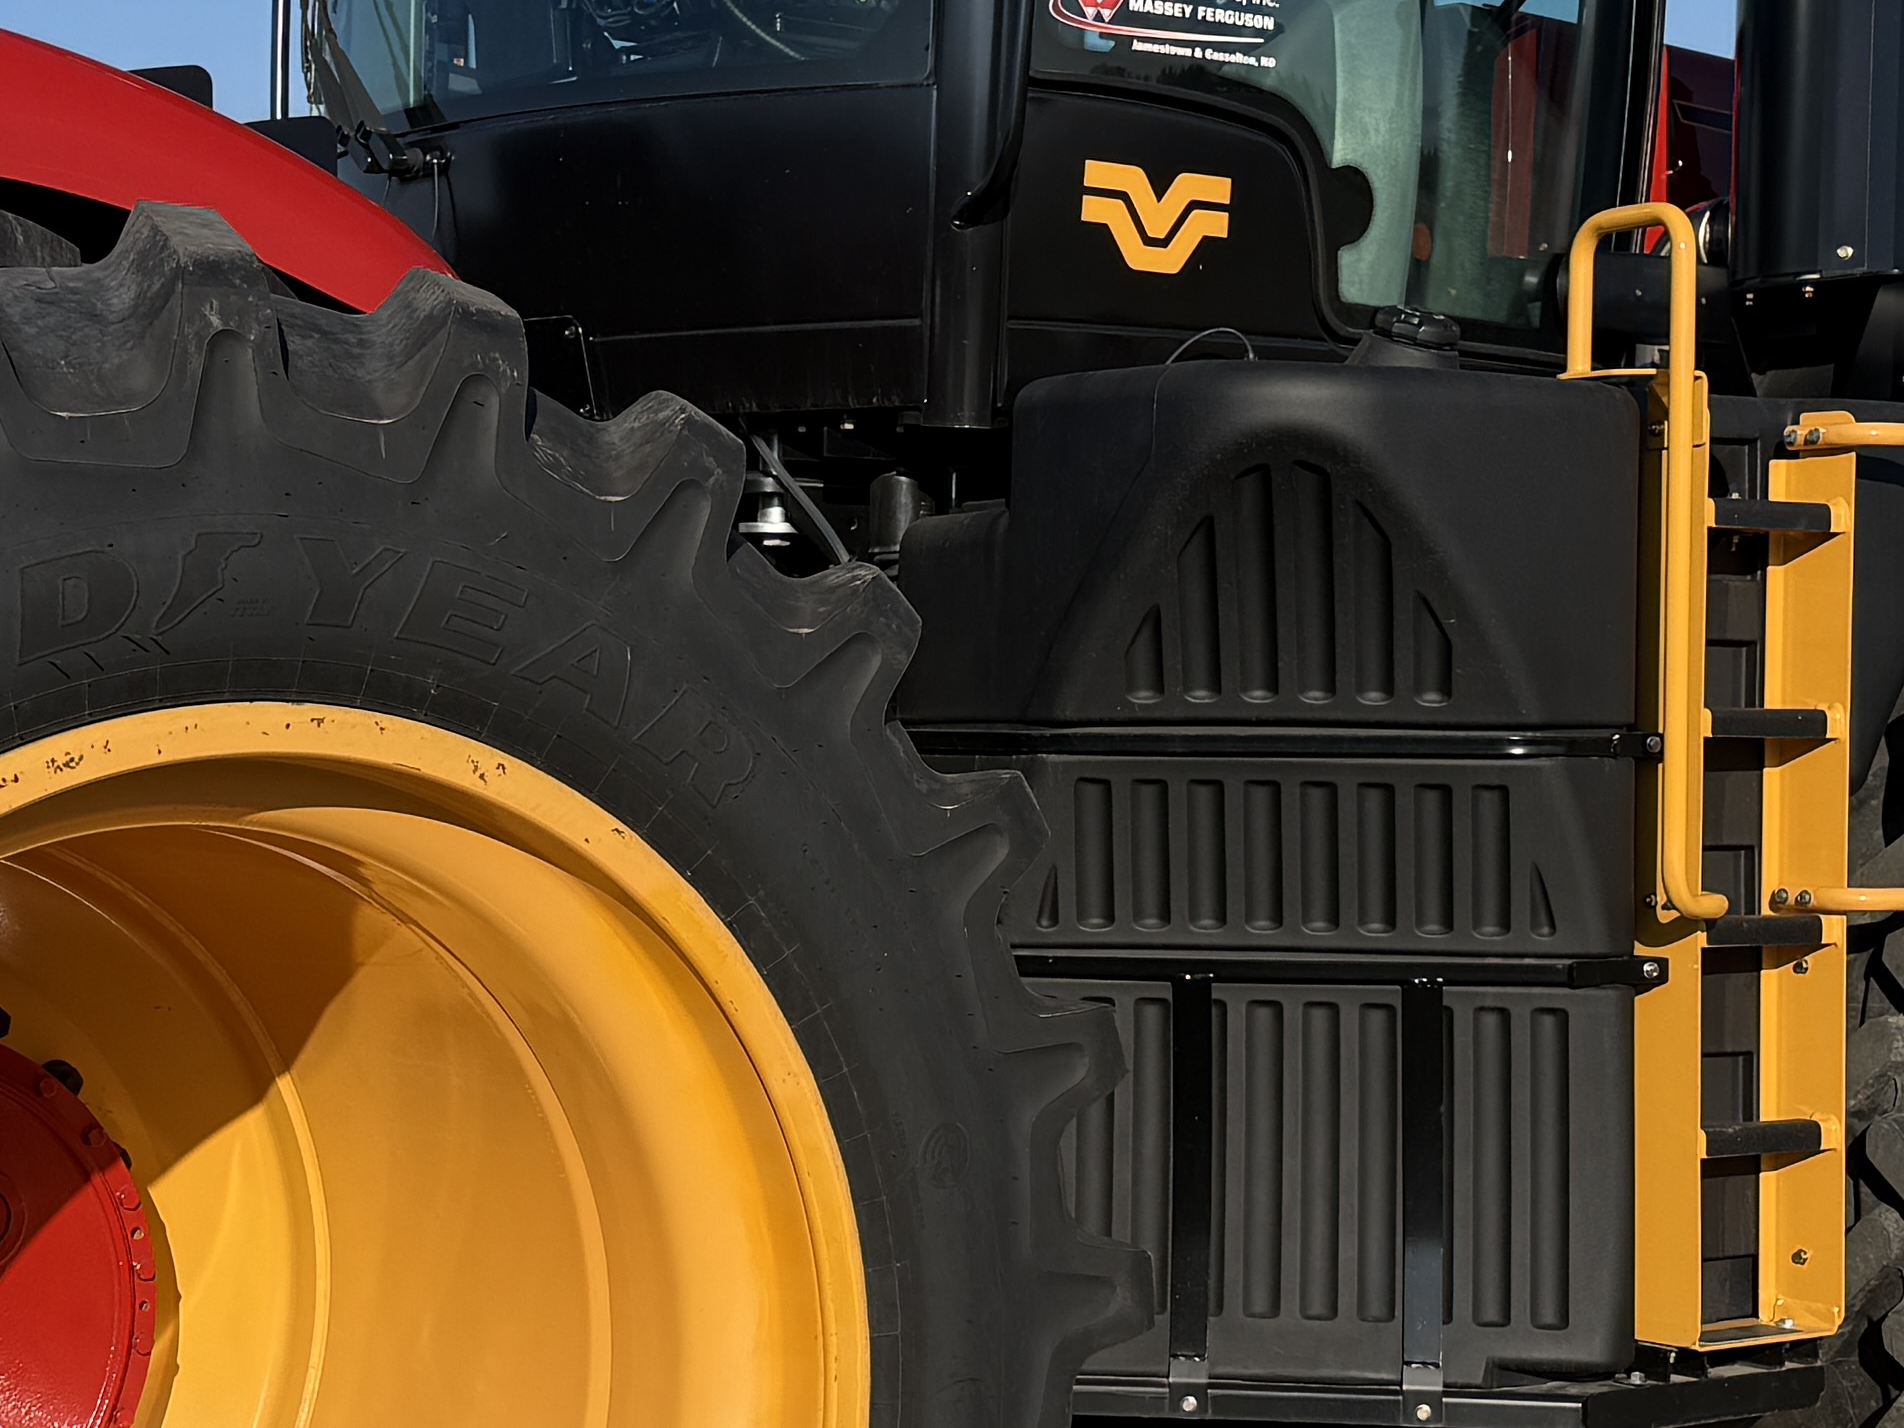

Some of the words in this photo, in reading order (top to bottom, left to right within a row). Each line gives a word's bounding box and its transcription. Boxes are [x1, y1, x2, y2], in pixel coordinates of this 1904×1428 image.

[1197, 6, 1275, 31] FERGUSON
[1131, 39, 1193, 57] Jamestown
[1193, 47, 1203, 59] &
